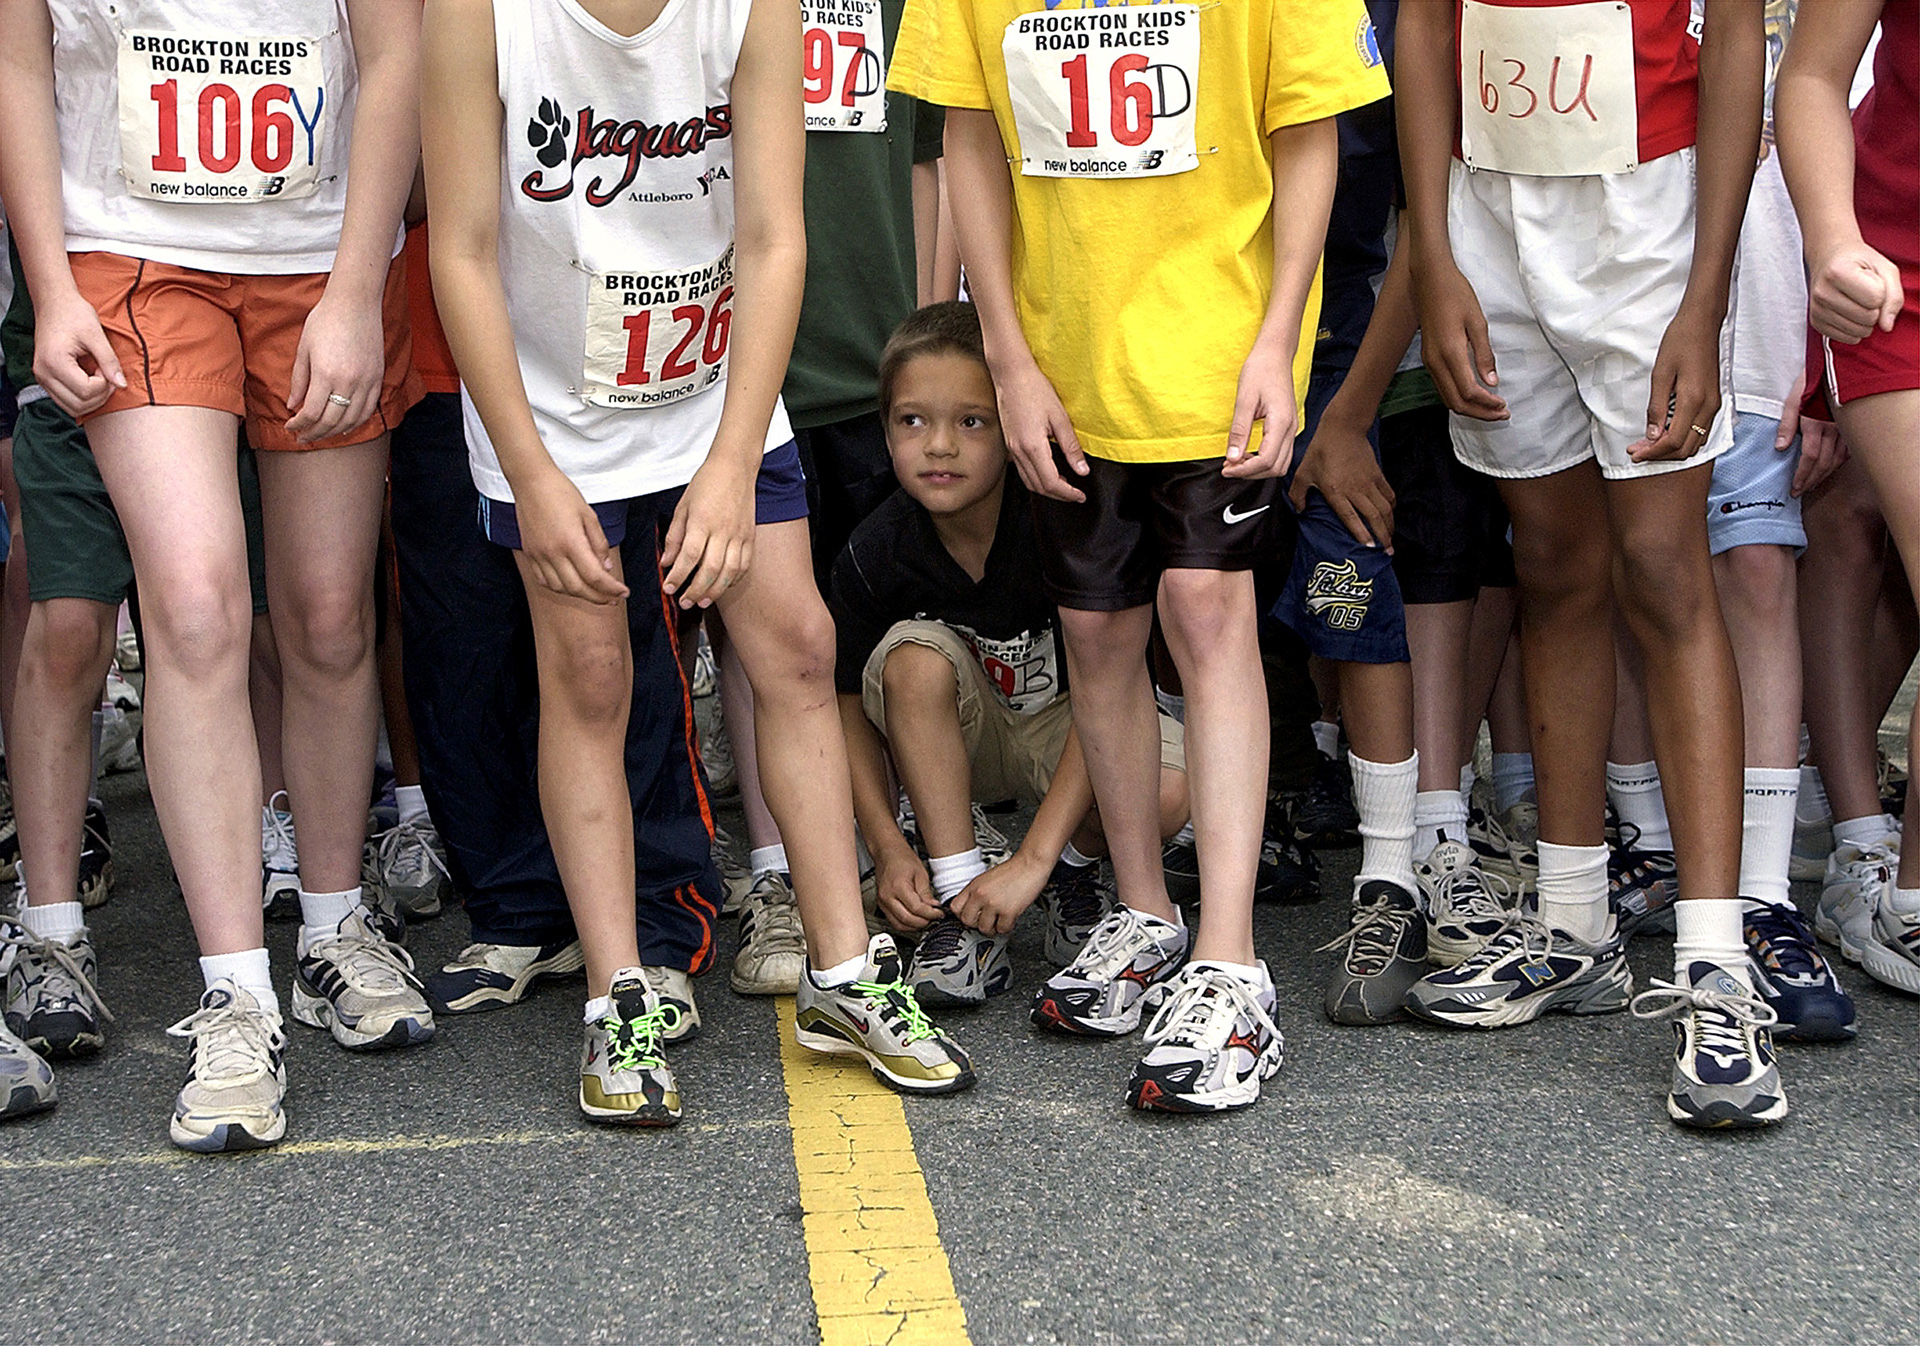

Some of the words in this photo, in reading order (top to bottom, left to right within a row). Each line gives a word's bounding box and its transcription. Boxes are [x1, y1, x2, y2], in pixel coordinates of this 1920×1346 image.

[817, 12, 863, 27] RACES
[1019, 13, 1127, 33] BROCKTON
[1138, 11, 1186, 28] KIDS
[133, 36, 249, 57] BROCKTON
[259, 42, 308, 57] KIDS
[1035, 33, 1089, 50] ROAD
[1100, 30, 1169, 48] RACES
[152, 55, 210, 73] ROAD
[220, 59, 292, 75] RACES
[1044, 160, 1067, 171] new
[1070, 158, 1127, 172] balance
[151, 183, 180, 195] new
[184, 182, 247, 197] balance
[629, 192, 693, 203] Attleboro
[605, 267, 713, 290] BROCKTON
[623, 290, 680, 305] ROAD
[688, 266, 733, 300] RACES
[616, 285, 734, 386] 126
[641, 383, 694, 403] balance
[1327, 604, 1367, 630] 05
